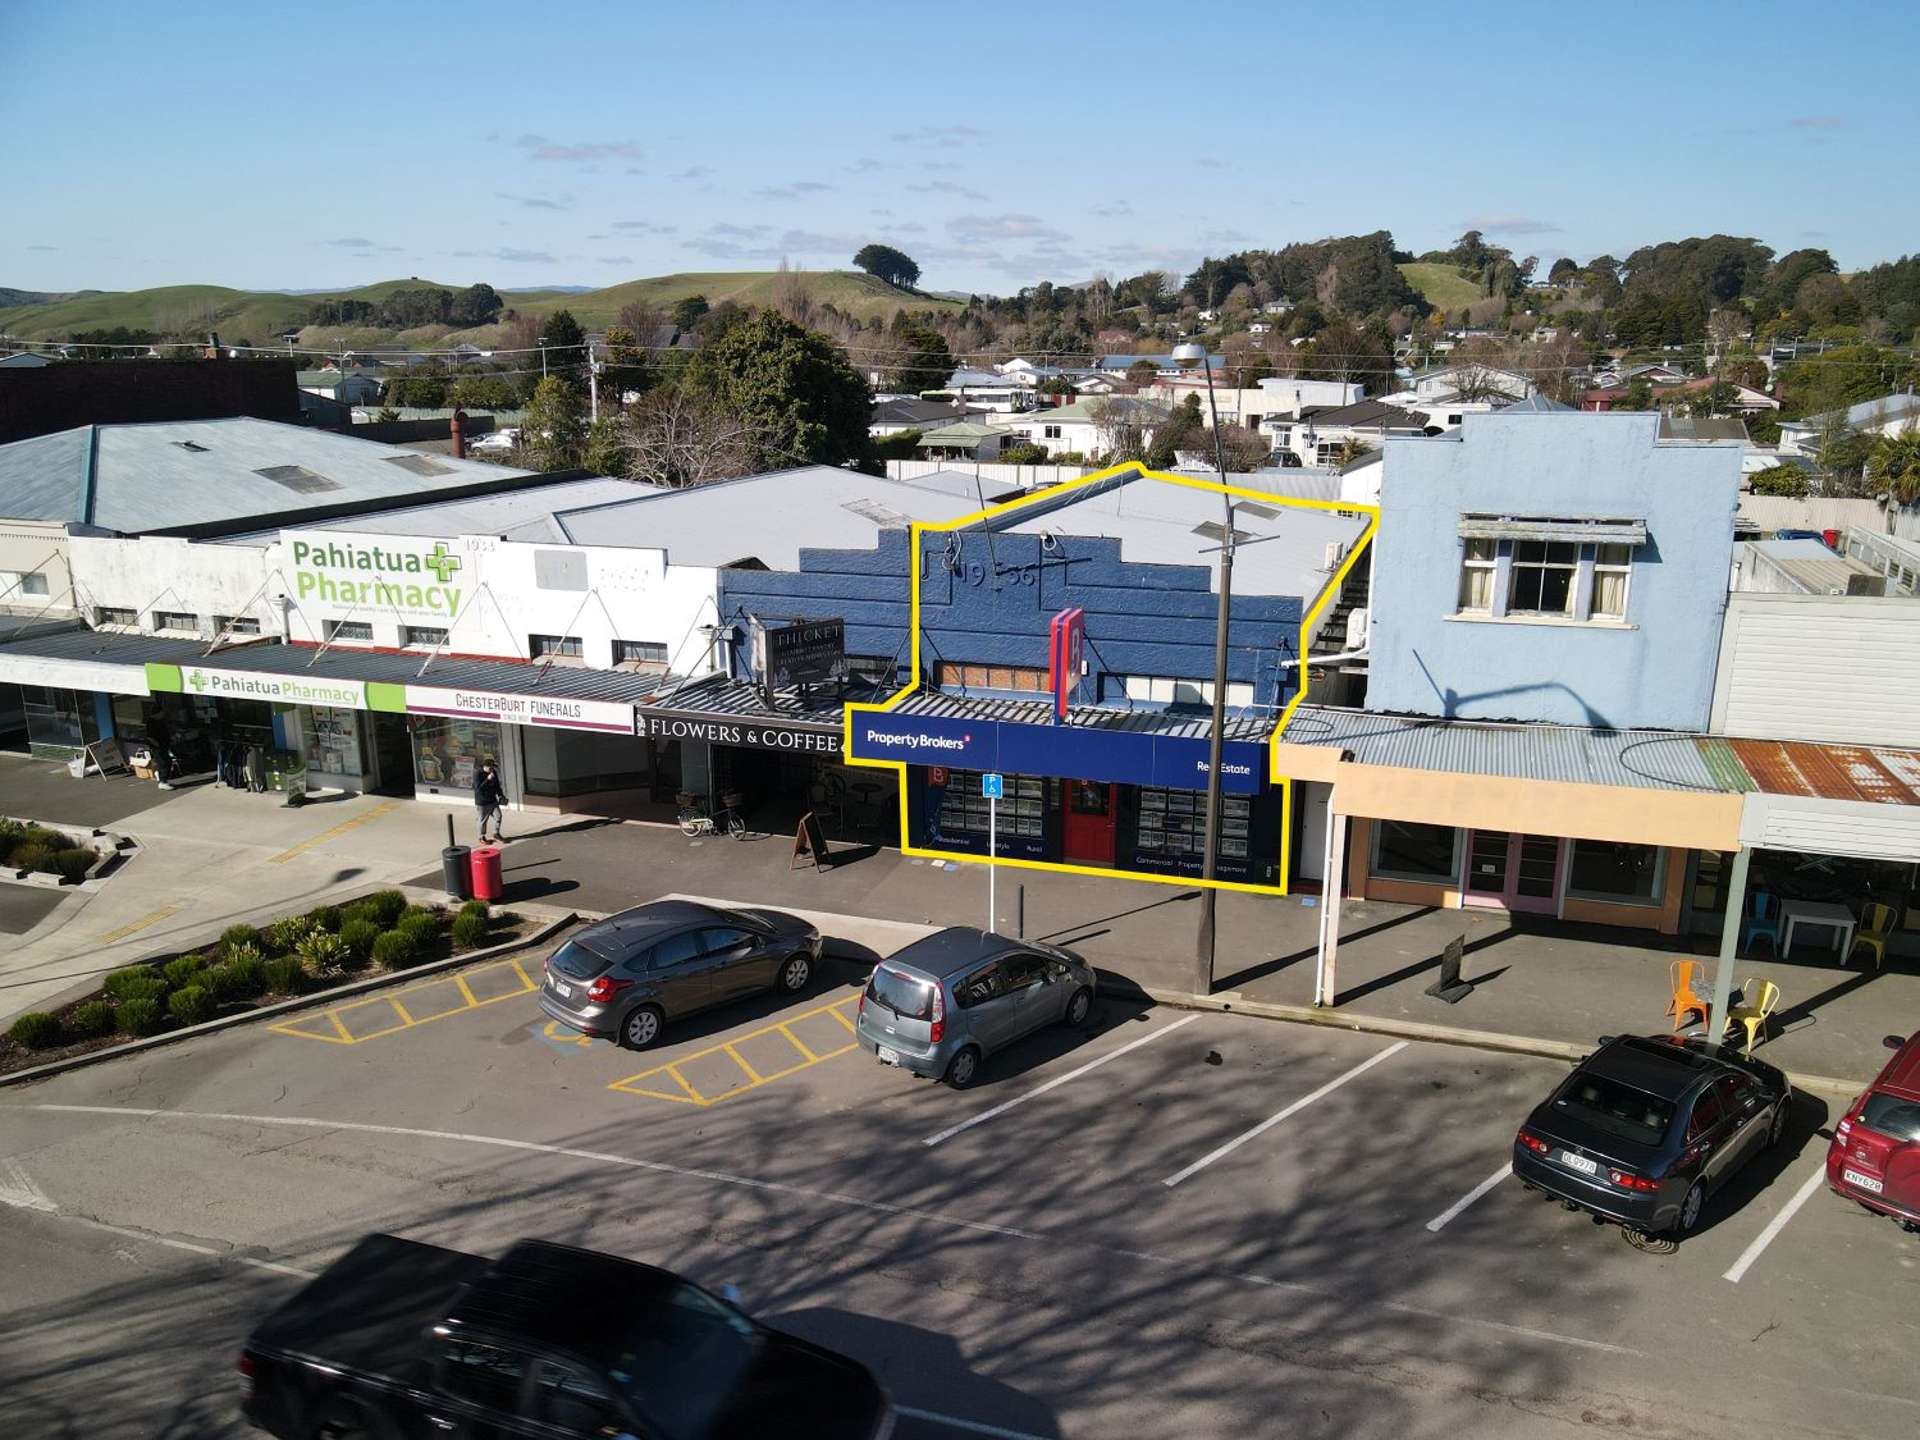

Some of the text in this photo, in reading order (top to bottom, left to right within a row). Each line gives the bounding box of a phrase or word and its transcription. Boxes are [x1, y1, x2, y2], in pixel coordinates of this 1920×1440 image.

[293, 541, 421, 573] Pahiatua
[297, 571, 461, 617] Pharmacy
[777, 625, 840, 647] THICKET
[530, 702, 581, 718] FUNERALS
[651, 719, 740, 743] FLOWERS
[747, 730, 758, 743] &
[762, 730, 838, 752] COFFEE
[1220, 763, 1251, 775] Estate
